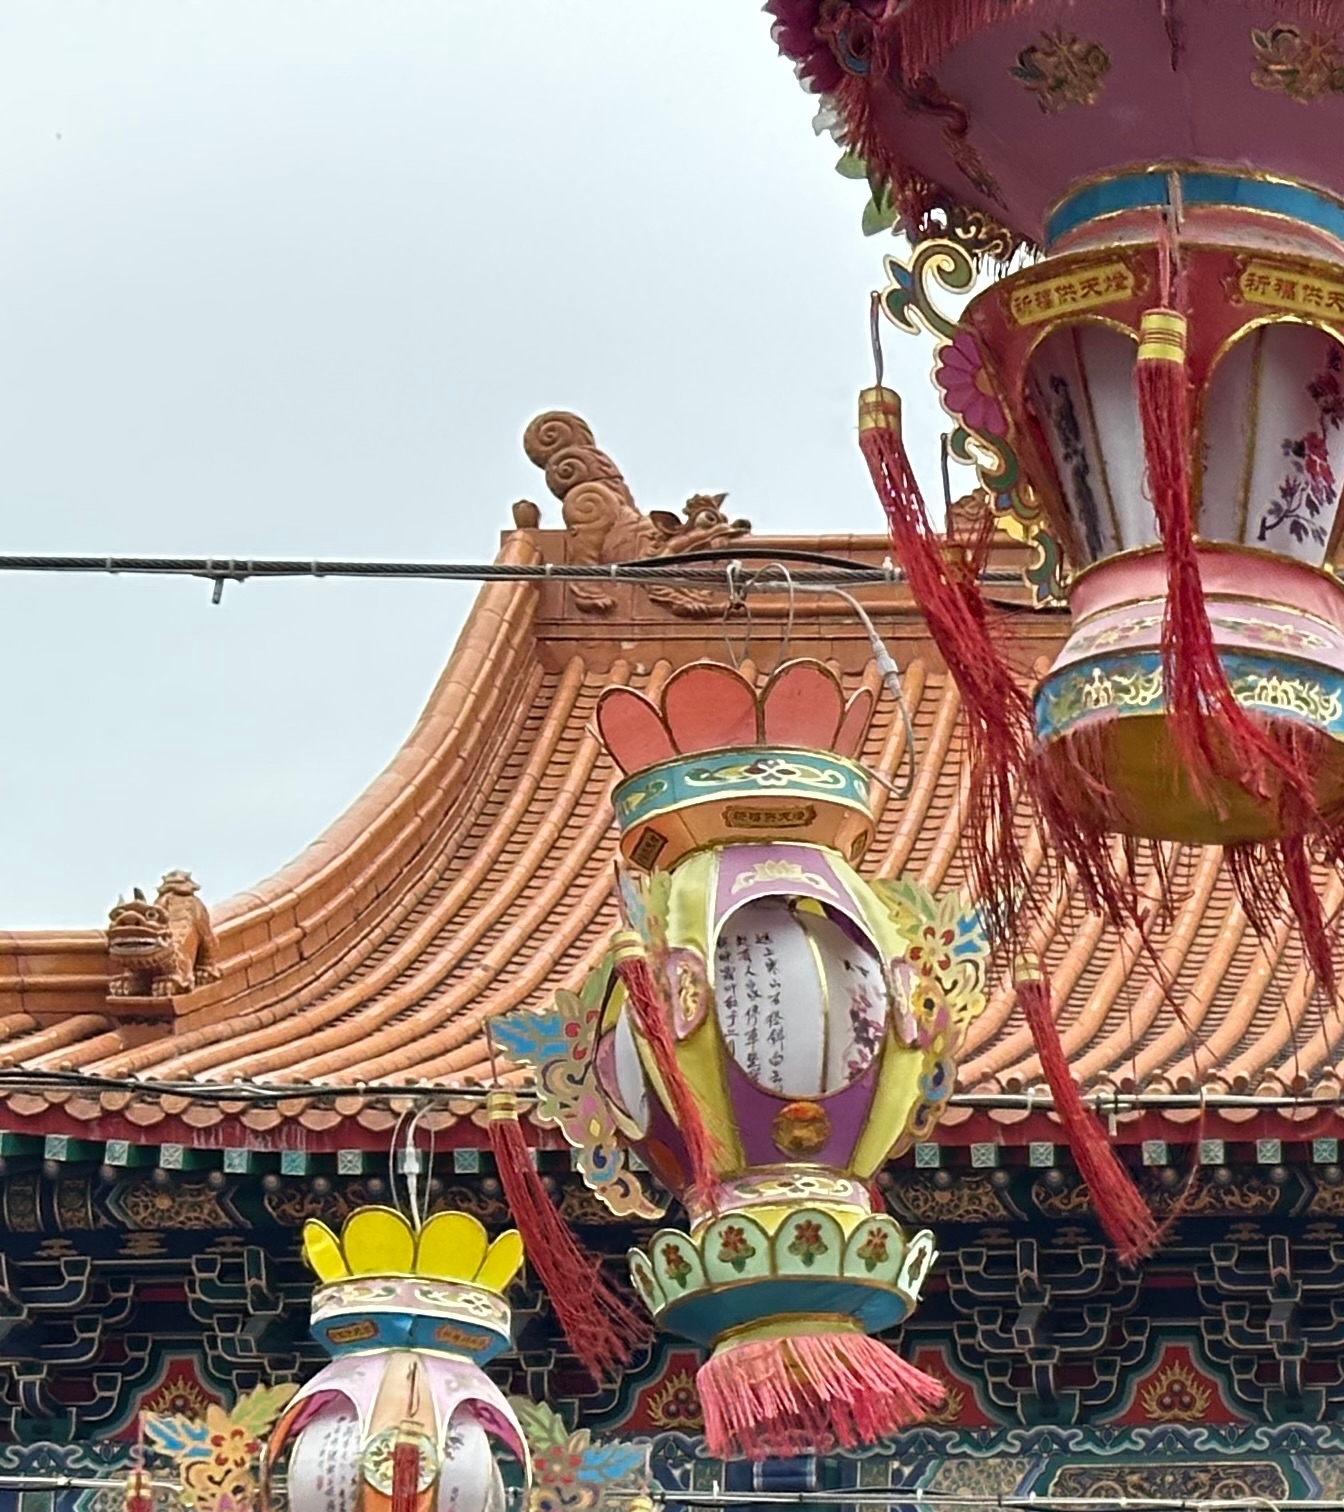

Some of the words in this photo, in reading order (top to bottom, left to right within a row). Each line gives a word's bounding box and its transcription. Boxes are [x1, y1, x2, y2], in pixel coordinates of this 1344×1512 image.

[1011, 268, 1130, 316] 祈福供天燈
